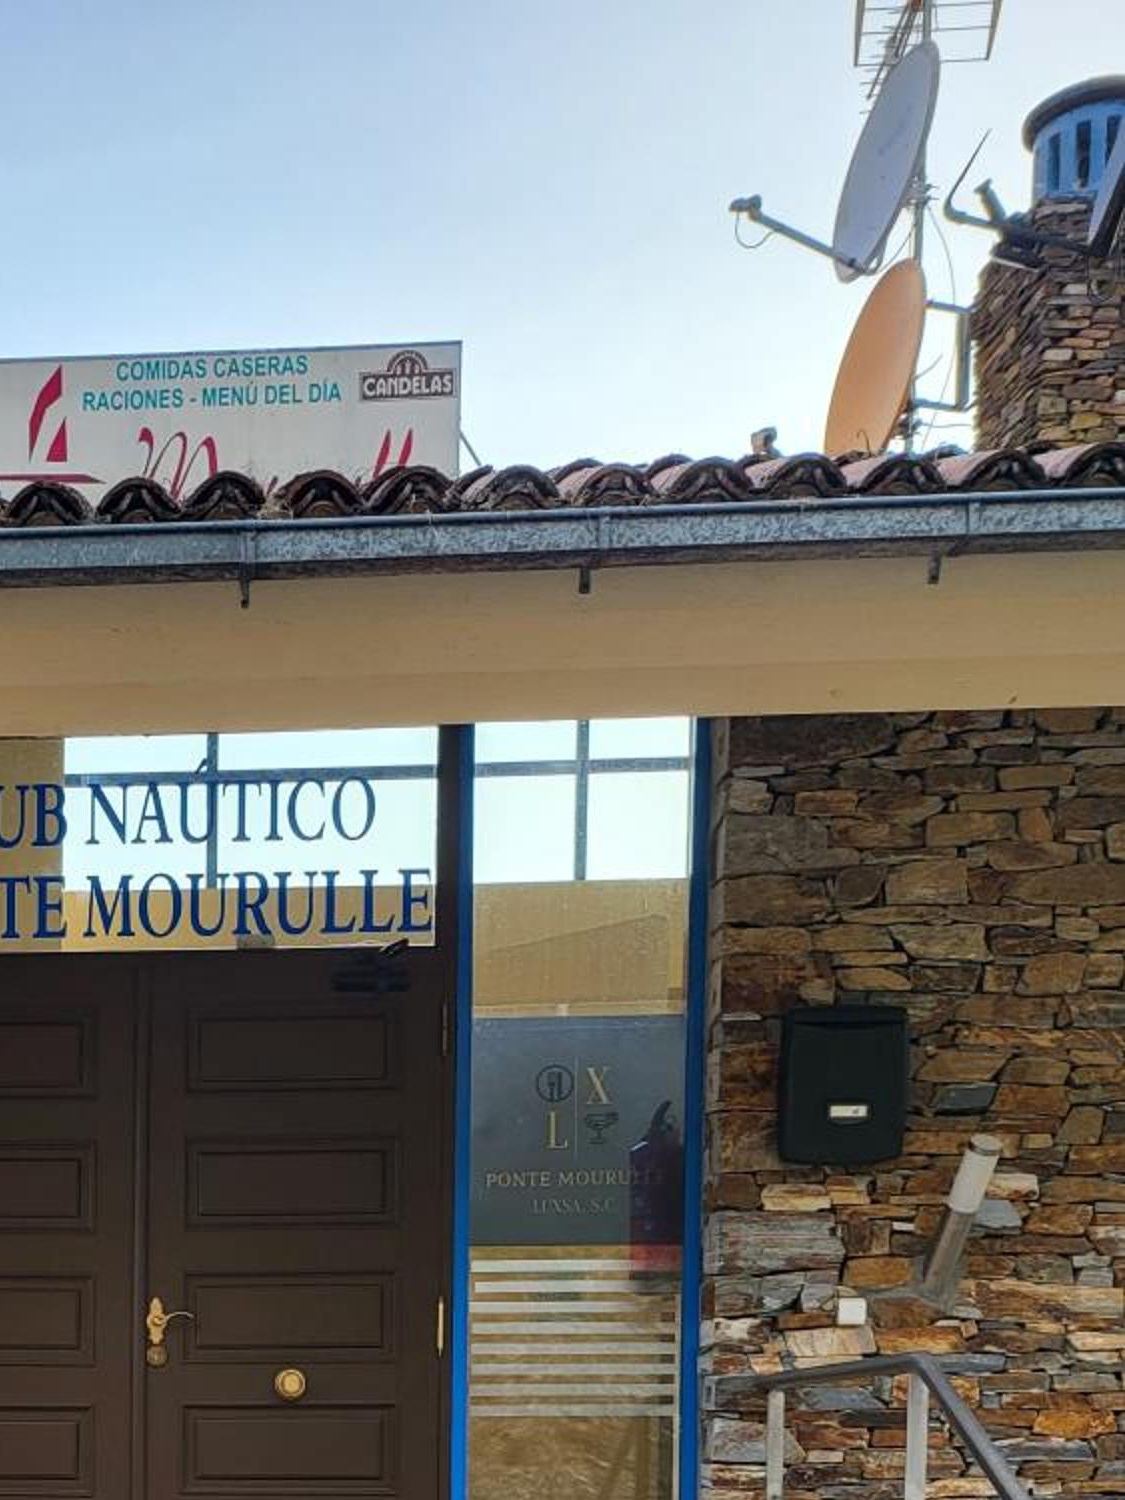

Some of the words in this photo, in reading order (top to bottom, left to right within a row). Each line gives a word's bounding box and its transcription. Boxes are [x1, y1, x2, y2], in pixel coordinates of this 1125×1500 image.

[115, 356, 207, 382] COMIDAS
[213, 354, 308, 380] CASERAS
[82, 386, 184, 412] RACIONES
[202, 380, 258, 407] MENÚ
[264, 383, 303, 405] DEL
[307, 377, 342, 403] DÍA
[362, 373, 454, 397] CANDELAS
[86, 757, 377, 845] NAÚTICO
[86, 866, 433, 938] MOURULLE
[486, 1171, 551, 1188] PONTE
